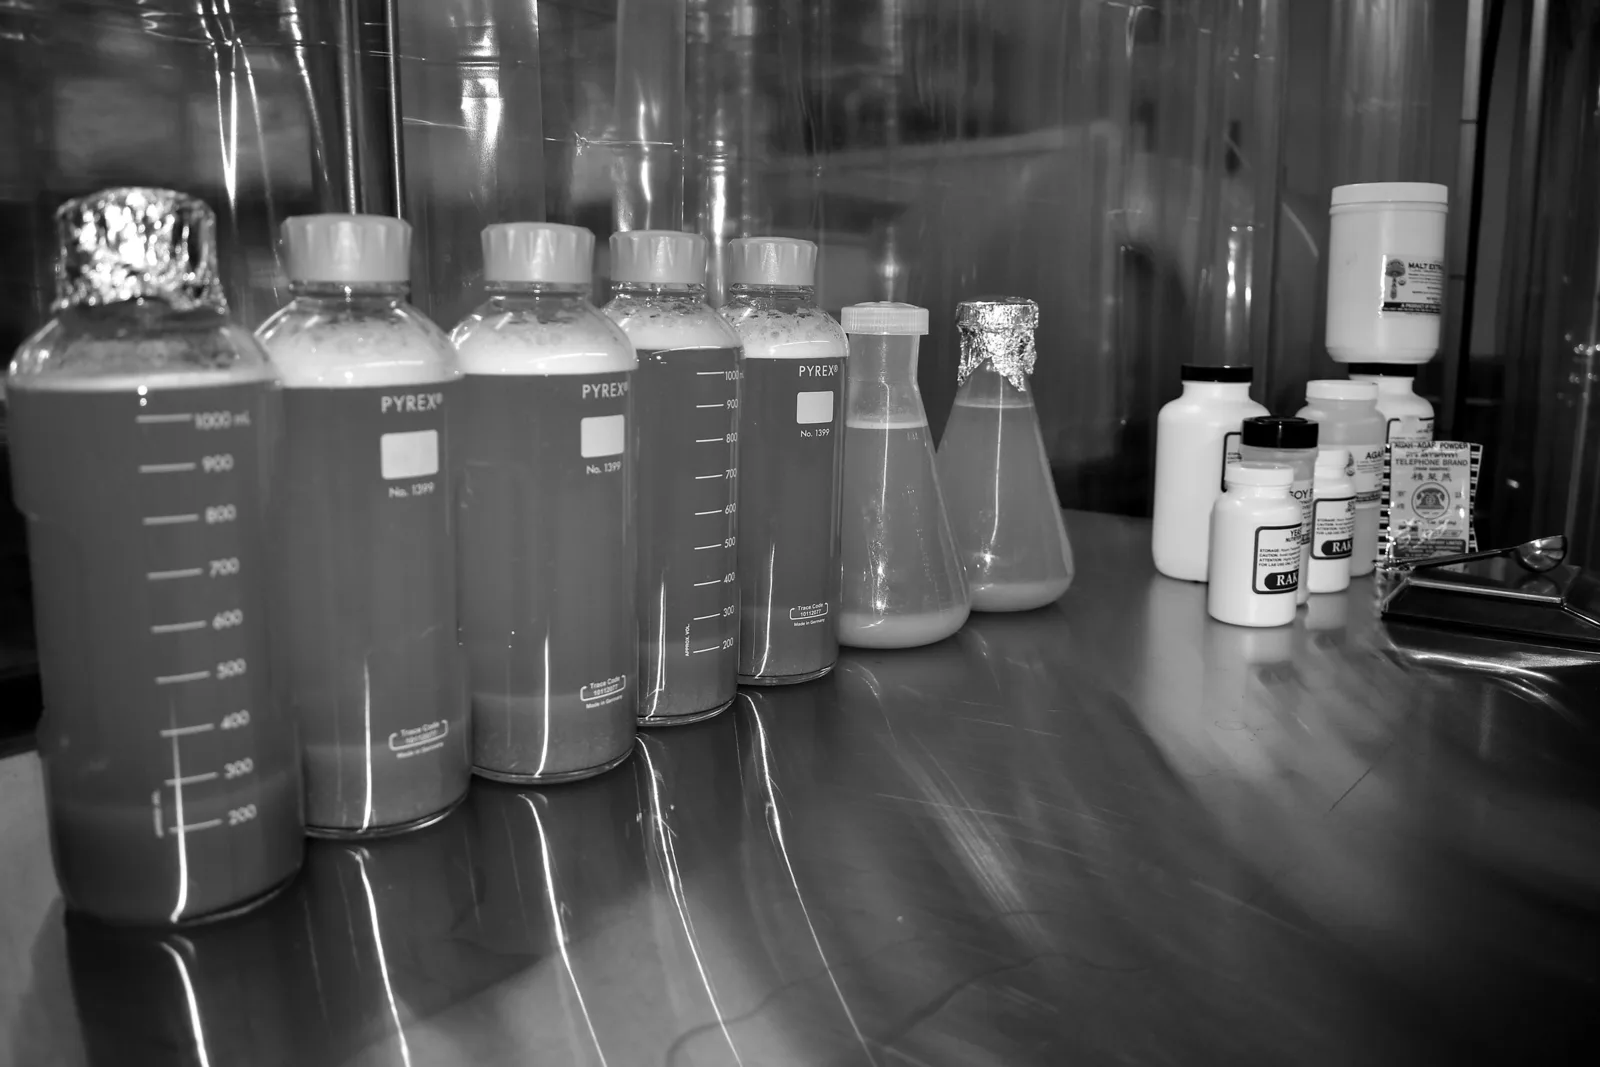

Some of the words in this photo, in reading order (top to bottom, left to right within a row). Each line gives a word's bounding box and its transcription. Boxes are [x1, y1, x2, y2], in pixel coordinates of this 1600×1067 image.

[725, 370, 739, 381] 1000
[726, 399, 739, 410] 900
[195, 411, 231, 430] 1000
[726, 432, 738, 443] 800
[815, 428, 830, 437] 1399
[202, 454, 234, 473] 900
[585, 465, 602, 475] No.
[604, 461, 621, 473] 1399
[726, 468, 737, 479] 700
[205, 504, 237, 524] 800
[725, 503, 737, 514] 600
[725, 537, 736, 548] 500
[209, 557, 240, 579] 700
[724, 572, 735, 583] 400
[723, 605, 735, 617] 300
[212, 608, 243, 631] 600
[722, 637, 734, 650] 200
[216, 658, 247, 680] 500
[220, 709, 250, 730] 400
[224, 757, 254, 779] 300
[228, 804, 257, 826] 200
